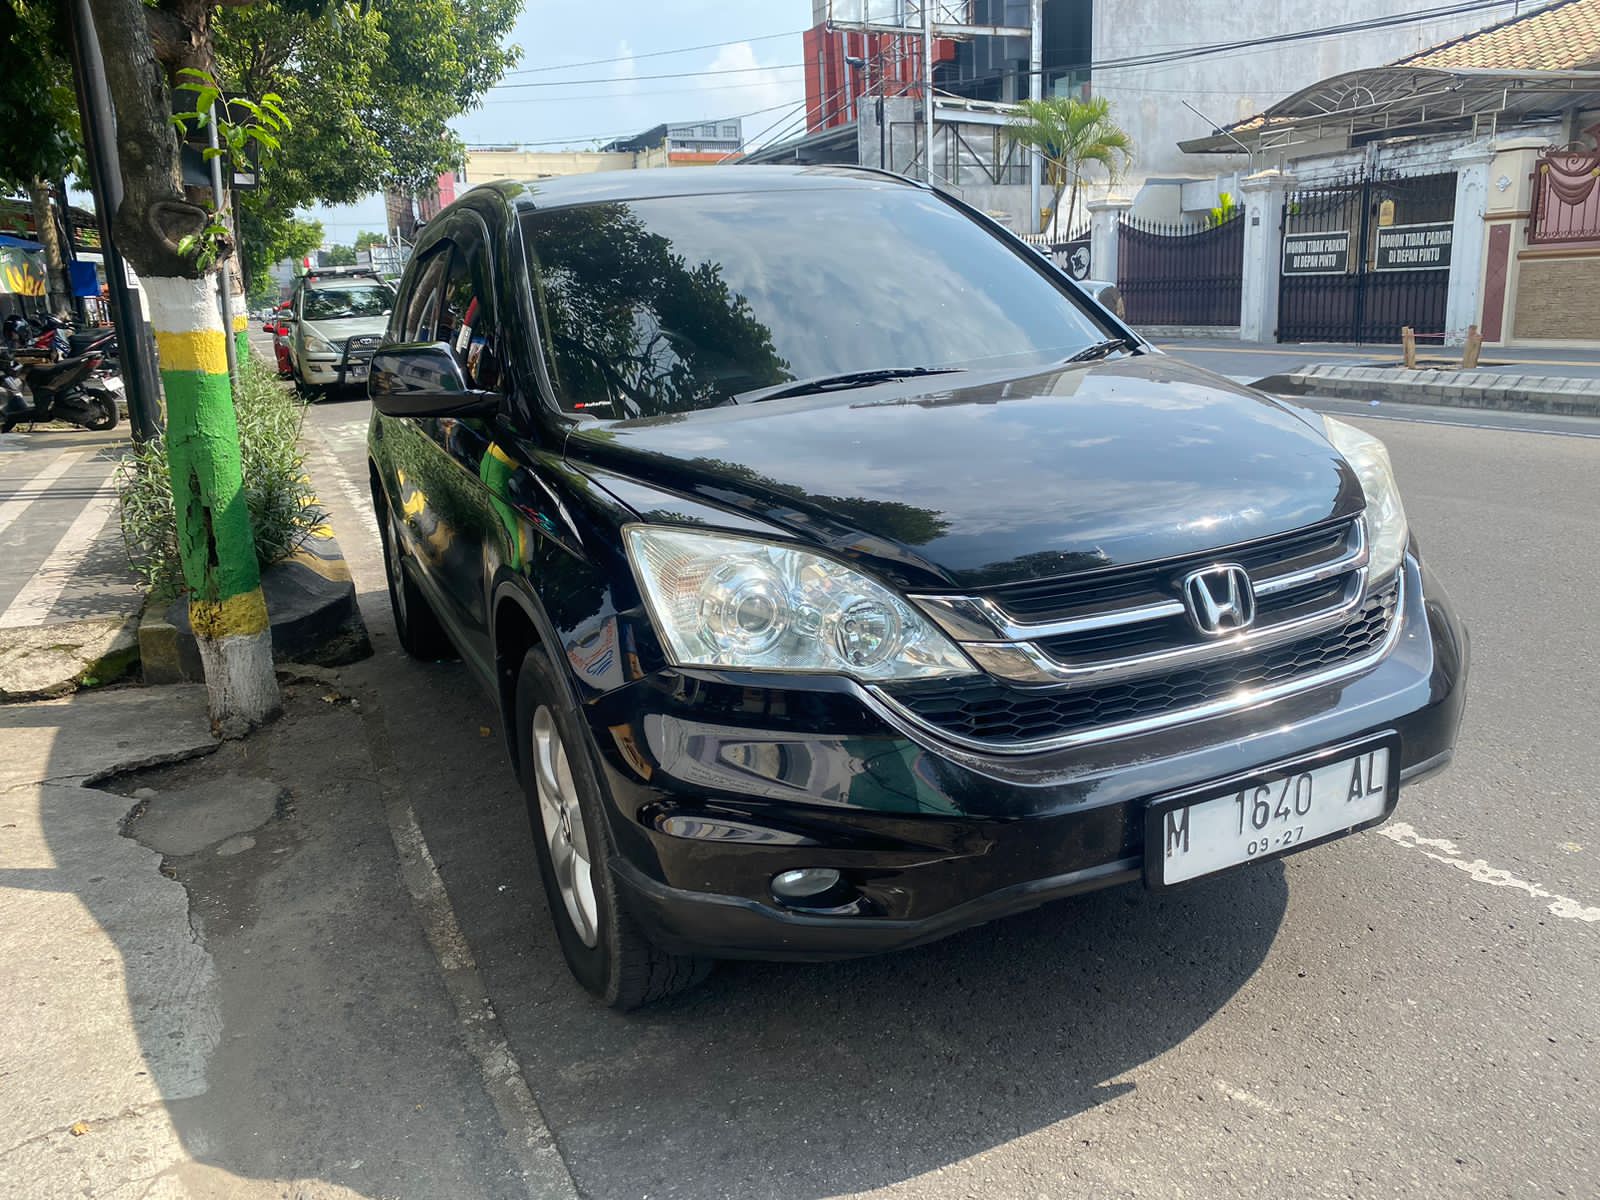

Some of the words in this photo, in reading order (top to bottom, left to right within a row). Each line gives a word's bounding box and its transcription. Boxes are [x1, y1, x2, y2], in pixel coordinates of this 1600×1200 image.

[1405, 232, 1426, 247] TIDAK
[1426, 230, 1452, 246] PARKIR
[1293, 255, 1301, 268] DI
[1300, 254, 1319, 268] DEPAN
[1319, 253, 1337, 267] PINTU
[1388, 249, 1397, 264] DI
[1396, 248, 1419, 263] DEPAN
[1418, 247, 1440, 262] PINTU
[1166, 806, 1190, 858] M
[1235, 772, 1313, 836] 1640
[1346, 752, 1383, 803] AL
